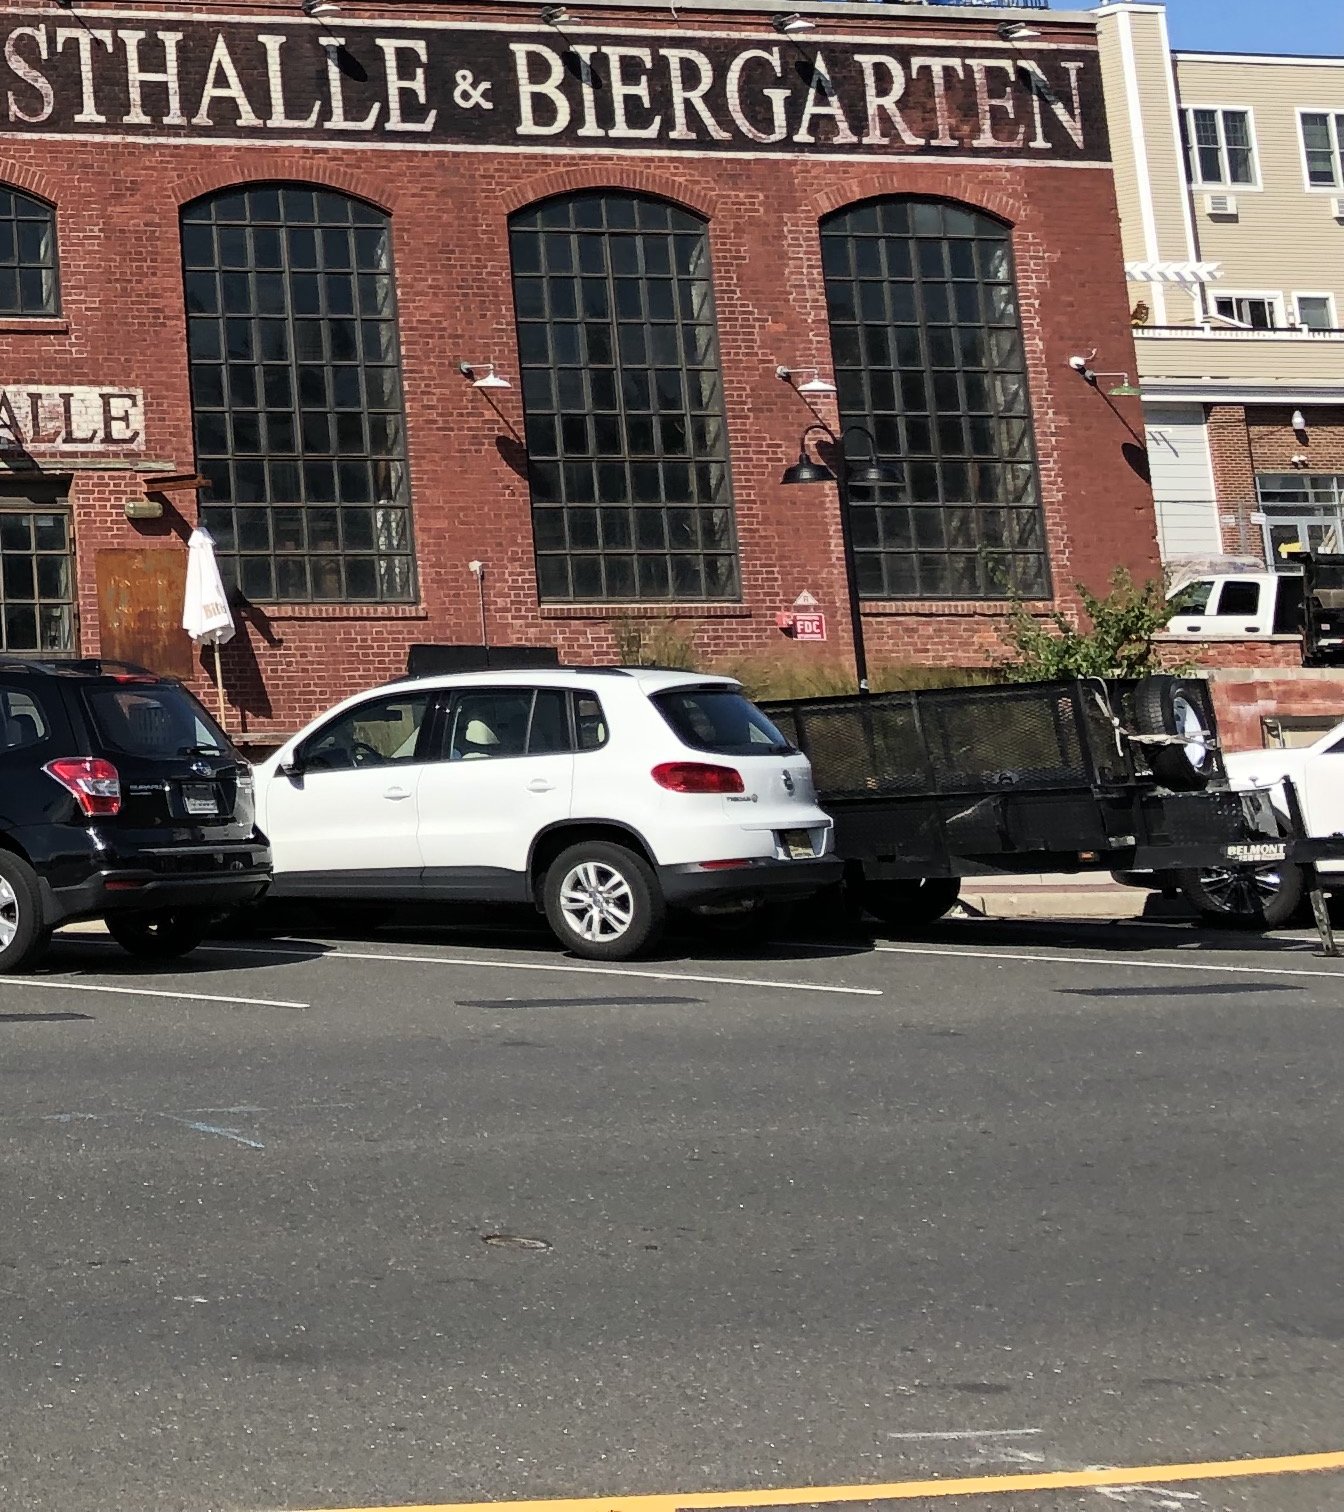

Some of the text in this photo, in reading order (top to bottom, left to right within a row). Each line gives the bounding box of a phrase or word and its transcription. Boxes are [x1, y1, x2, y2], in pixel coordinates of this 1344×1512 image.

[453, 68, 494, 111] &
[508, 41, 1086, 151] BIERGARTEN
[796, 620, 821, 633] FDC
[1227, 843, 1287, 856] BELMONT
